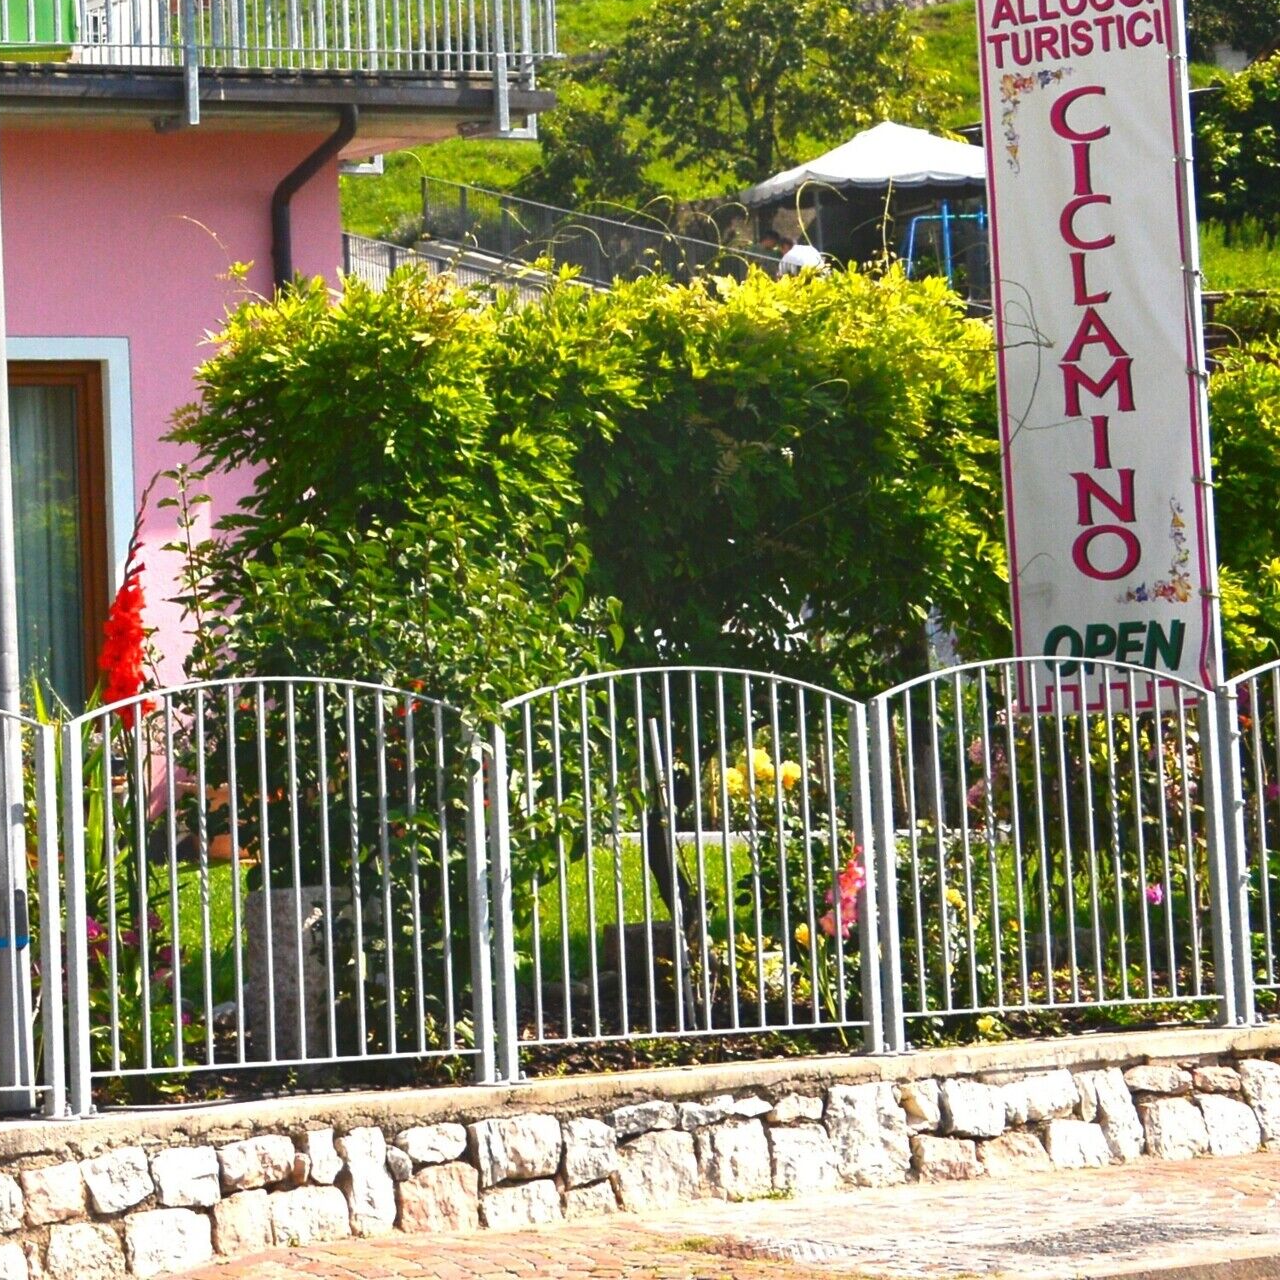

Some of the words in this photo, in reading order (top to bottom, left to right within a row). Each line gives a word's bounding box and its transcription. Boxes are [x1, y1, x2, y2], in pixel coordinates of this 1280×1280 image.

[987, 8, 1164, 69] TURISTICI
[1049, 85, 1142, 581] CICLAMINO
[1043, 619, 1186, 677] OPEN
